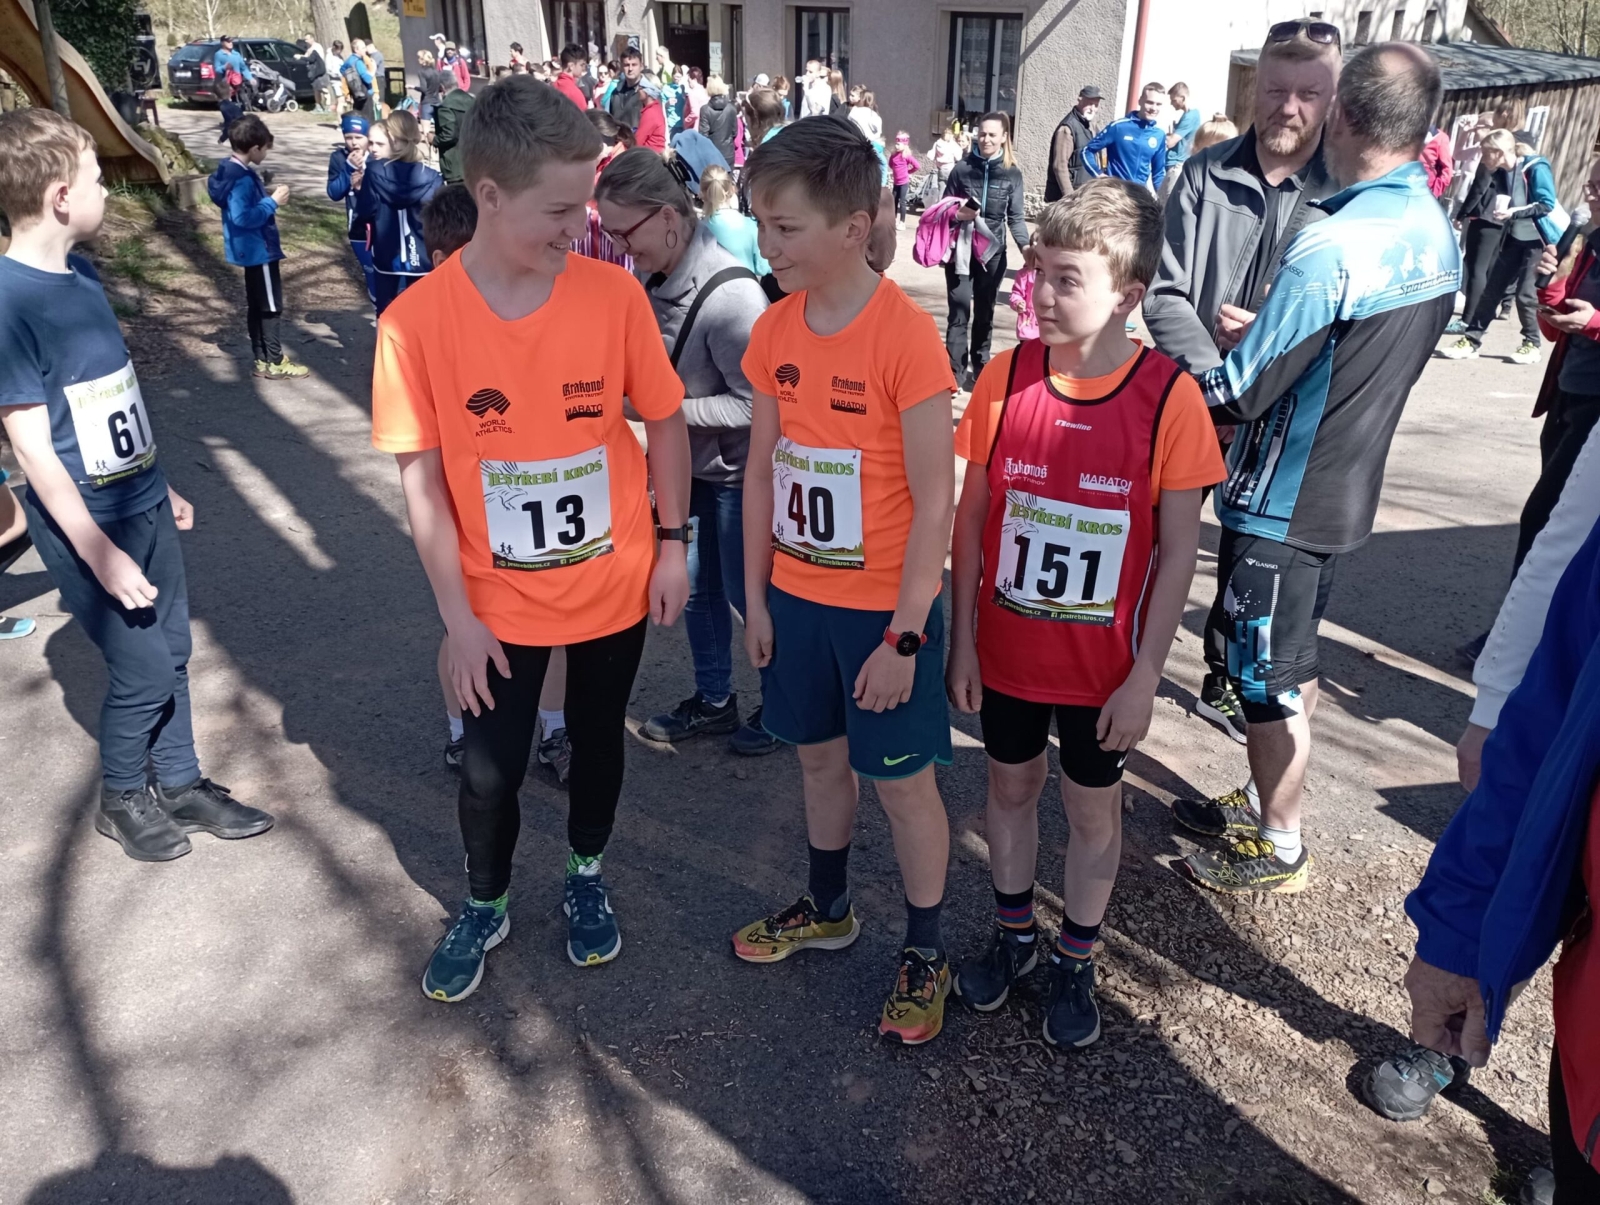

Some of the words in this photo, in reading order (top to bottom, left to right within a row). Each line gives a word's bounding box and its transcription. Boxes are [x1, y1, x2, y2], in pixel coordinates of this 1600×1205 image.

[585, 390, 604, 398] TRUTN
[107, 402, 148, 459] 61
[479, 419, 506, 429] WORLD
[488, 468, 558, 487] JESTŘEBÍ
[563, 459, 604, 482] KROS
[813, 460, 855, 476] KROS
[521, 494, 586, 550] 13
[787, 481, 835, 543] 40
[1009, 502, 1073, 530] JESTŘEBÍ
[1076, 519, 1123, 536] KROS
[1013, 534, 1102, 601] 151
[1059, 612, 1106, 624] jestrebikros.cz
